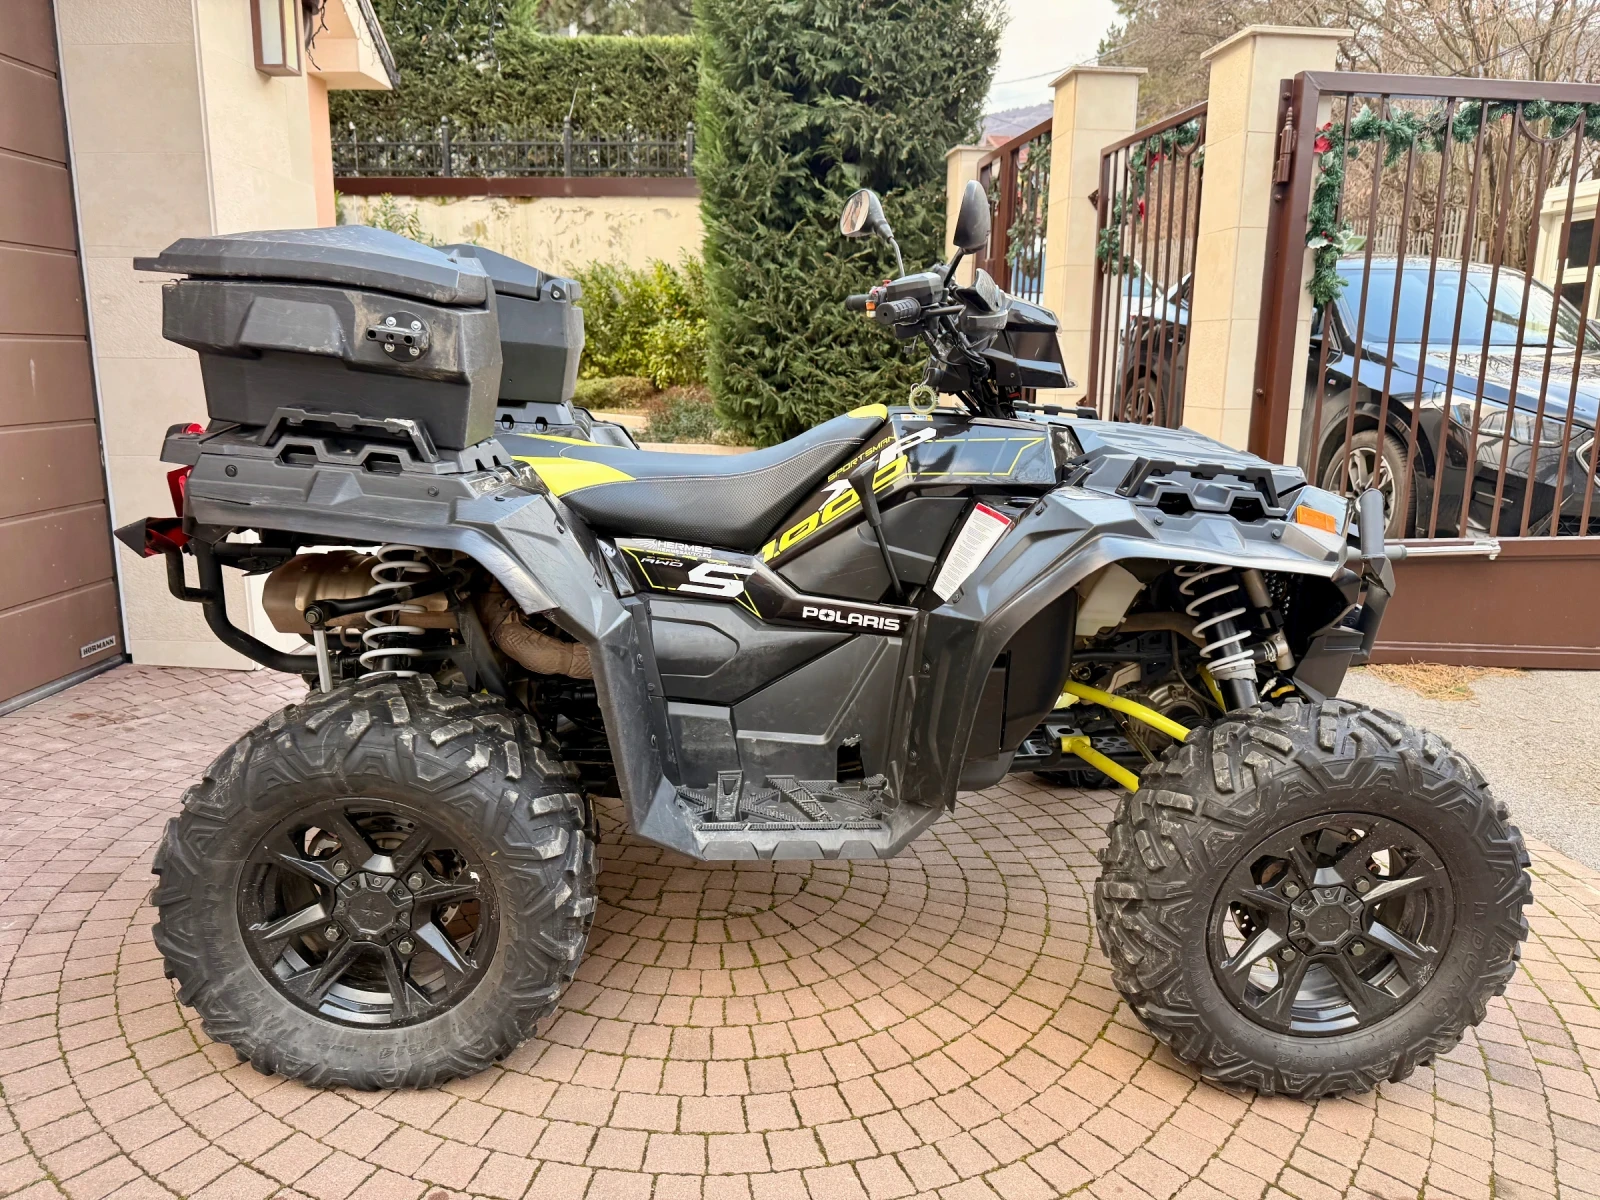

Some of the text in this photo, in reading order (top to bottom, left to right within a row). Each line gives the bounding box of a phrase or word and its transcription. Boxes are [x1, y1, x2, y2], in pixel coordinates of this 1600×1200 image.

[828, 436, 896, 482] SPORTSMAN
[658, 541, 712, 554] HERMES
[640, 557, 684, 567] AWD
[677, 563, 757, 598] S
[802, 606, 900, 631] POLARIS
